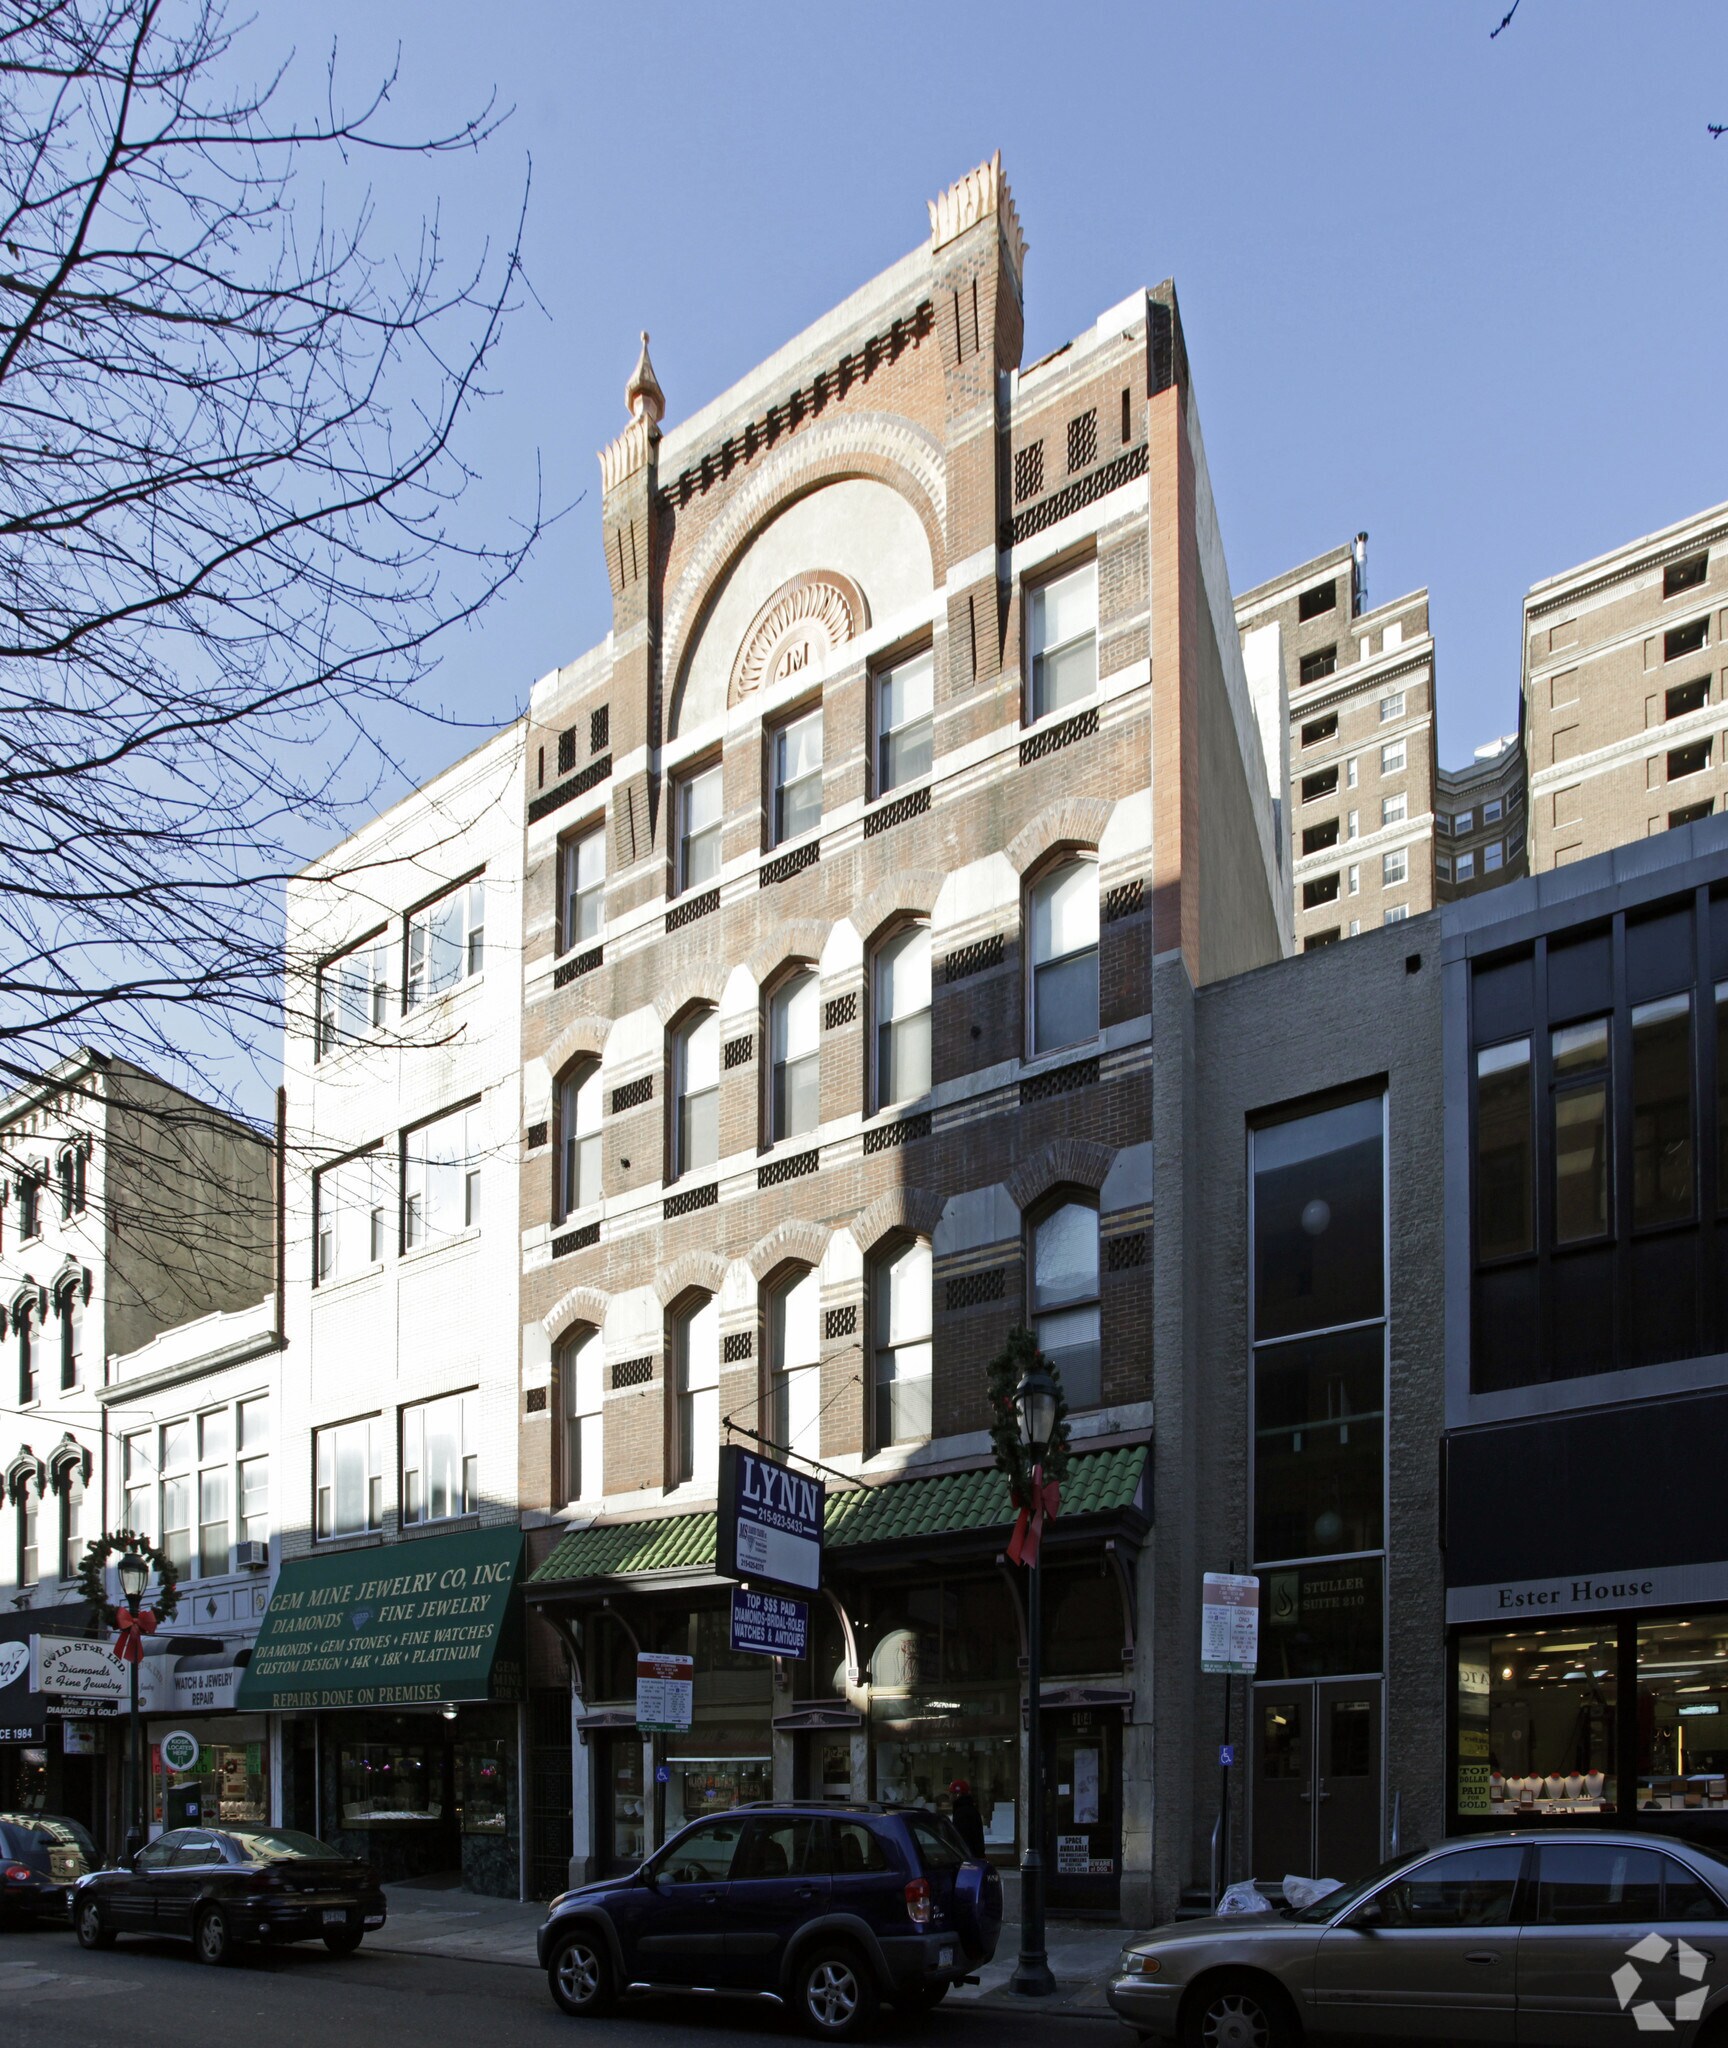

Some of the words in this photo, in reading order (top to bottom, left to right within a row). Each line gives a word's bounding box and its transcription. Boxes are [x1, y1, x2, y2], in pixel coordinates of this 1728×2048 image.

[742, 1455, 819, 1522] LYNN
[758, 1507, 803, 1534] 215-923-5433
[269, 1592, 305, 1613] GEM
[307, 1585, 353, 1608] MINE
[355, 1571, 437, 1601] JEWELRY
[472, 1561, 512, 1586] INC.
[1303, 1577, 1365, 1595] STULLER
[1497, 1588, 1561, 1609] Ester
[1570, 1580, 1654, 1602] House
[746, 1593, 761, 1610] TOP
[763, 1596, 778, 1614] $$$
[781, 1600, 796, 1617] PAID
[1302, 1597, 1341, 1611] SUITE
[1342, 1594, 1365, 1608] 210
[272, 1612, 344, 1635] DIAMONDS
[378, 1603, 416, 1623] FINE
[416, 1594, 492, 1619] JEWELRY
[256, 1641, 313, 1659] DIAMONDS
[320, 1639, 346, 1654] GEM
[346, 1634, 393, 1652] STONES
[399, 1630, 432, 1646] FINE
[433, 1623, 495, 1644] WATCHES
[734, 1622, 765, 1642] WATCHES
[767, 1627, 773, 1643] &
[775, 1630, 804, 1648] ANTIQUES
[57, 1660, 110, 1677] Diamonds
[256, 1659, 300, 1676] CUSTOM
[301, 1656, 344, 1673] DESIGN
[350, 1655, 371, 1669] 14K
[380, 1651, 403, 1667] 18K
[412, 1645, 481, 1664] PLATINUM
[495, 1660, 520, 1673] GEM
[45, 1676, 53, 1685] &
[56, 1675, 82, 1688] Fine
[83, 1677, 123, 1693] Jewelry
[174, 1675, 197, 1691] WATCH
[198, 1675, 204, 1688] &
[205, 1672, 233, 1688] JEWELRY
[81, 1700, 104, 1708] BUY
[191, 1691, 215, 1706] REPAIR
[273, 1690, 318, 1708] REPAIRS
[322, 1688, 354, 1706] DONE
[357, 1687, 376, 1704] ON
[380, 1683, 441, 1703] PREMISES
[46, 1705, 88, 1716] DIAMONDS
[88, 1708, 96, 1716] &
[97, 1708, 119, 1718] GOLD
[13, 1728, 34, 1739] 1984
[1459, 1767, 1489, 1775] TOP
[1461, 1786, 1486, 1795] PAID
[189, 1805, 196, 1814] P
[1459, 1801, 1488, 1809] GOLD
[1065, 1837, 1082, 1845] SPACE
